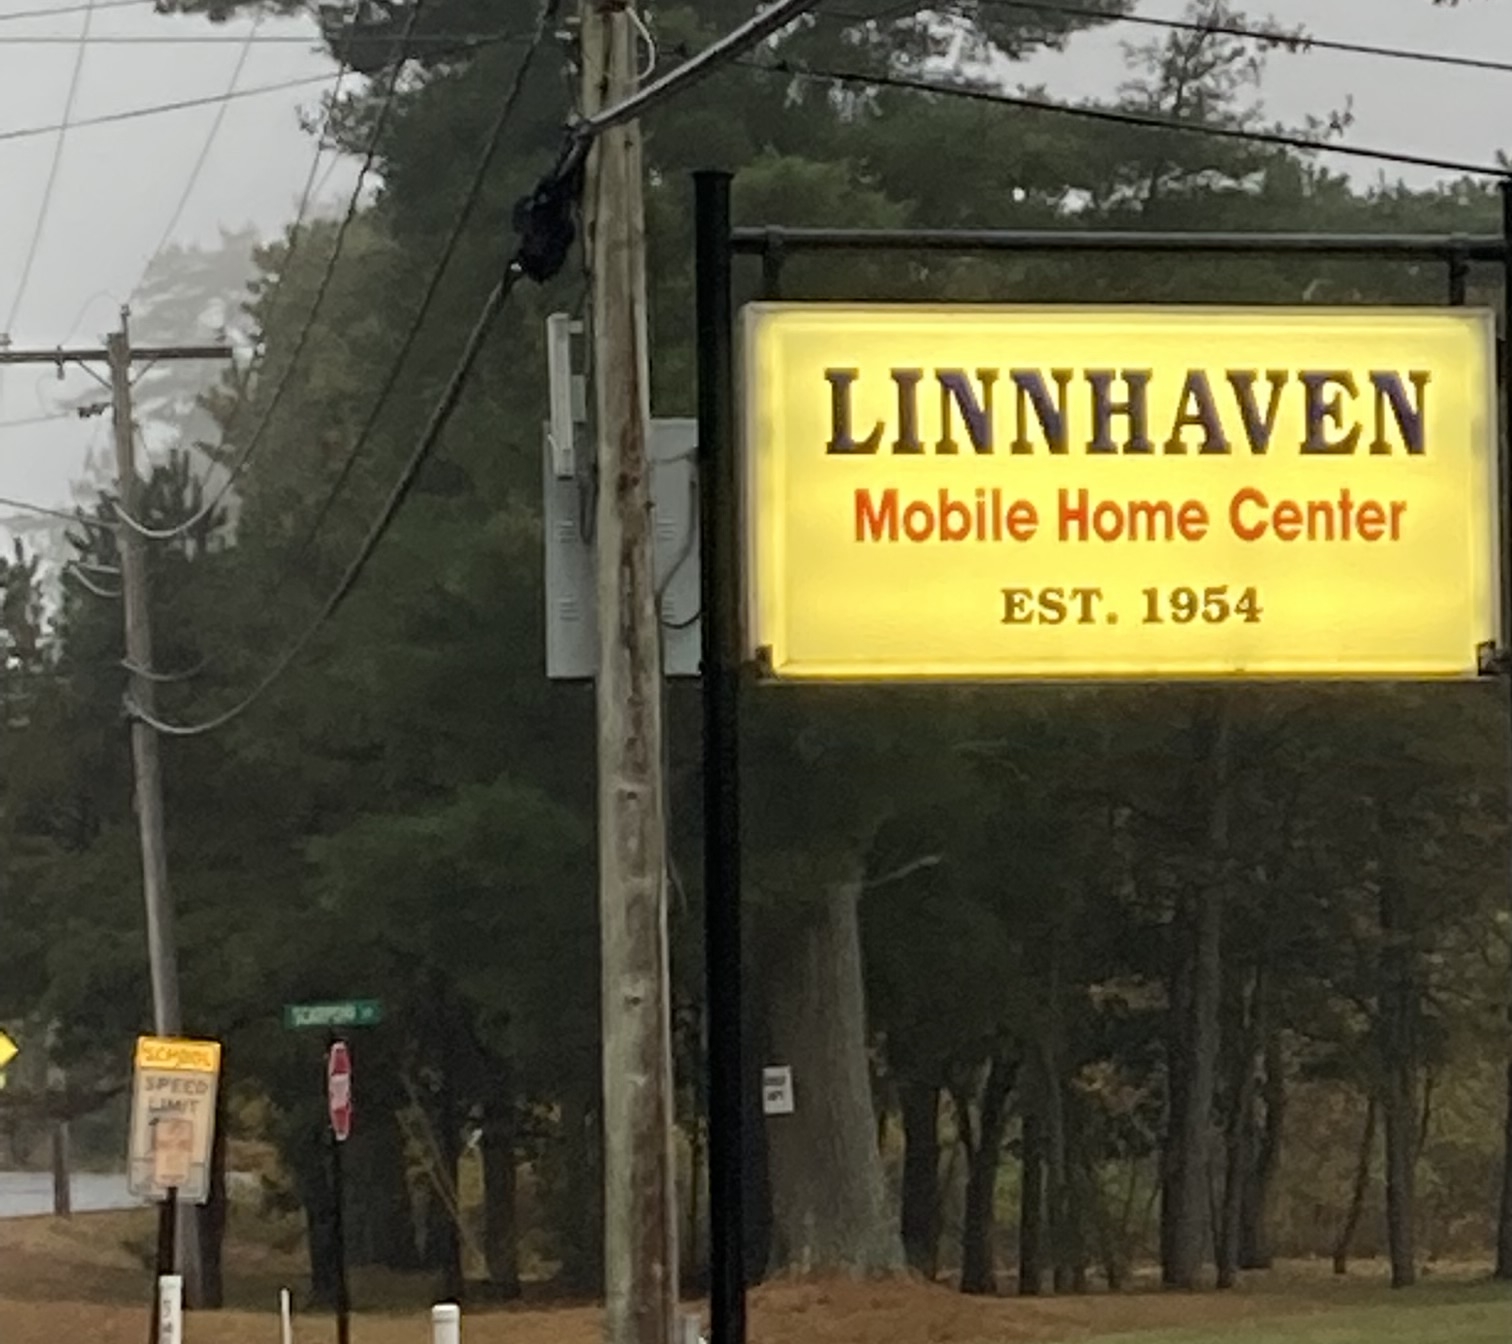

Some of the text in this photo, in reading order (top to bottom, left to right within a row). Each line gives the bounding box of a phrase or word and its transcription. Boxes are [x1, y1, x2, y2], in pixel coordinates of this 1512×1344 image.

[823, 367, 1431, 455] LINNHAVEN
[854, 487, 1407, 542] Mobile Home Center
[1000, 587, 1262, 624] EST. 1954
[145, 1076, 208, 1095] SPEED
[148, 1097, 201, 1115] LIMIT
